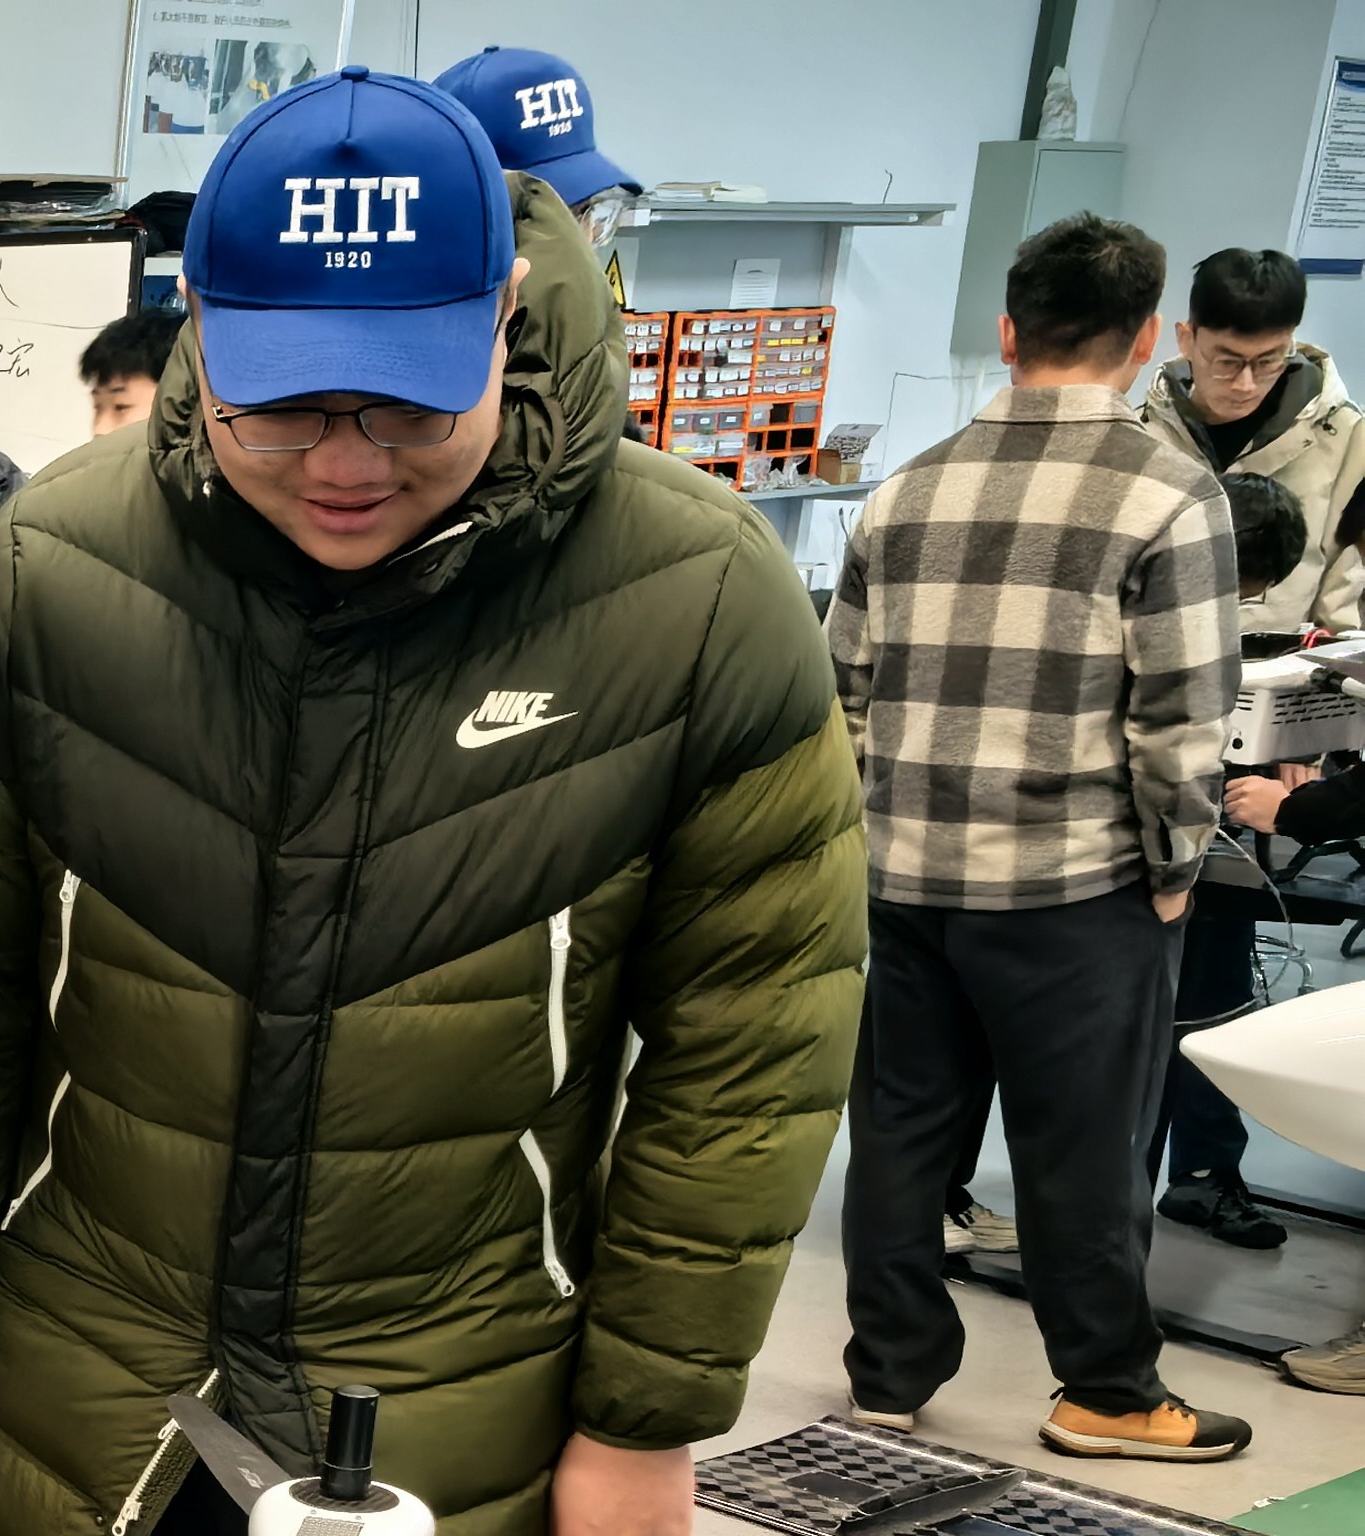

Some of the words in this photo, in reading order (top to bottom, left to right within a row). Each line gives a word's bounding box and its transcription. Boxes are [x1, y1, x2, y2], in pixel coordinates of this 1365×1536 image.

[515, 78, 584, 130] HIT
[279, 176, 420, 244] HIT
[324, 251, 372, 269] 1920
[475, 690, 555, 724] NIKE
